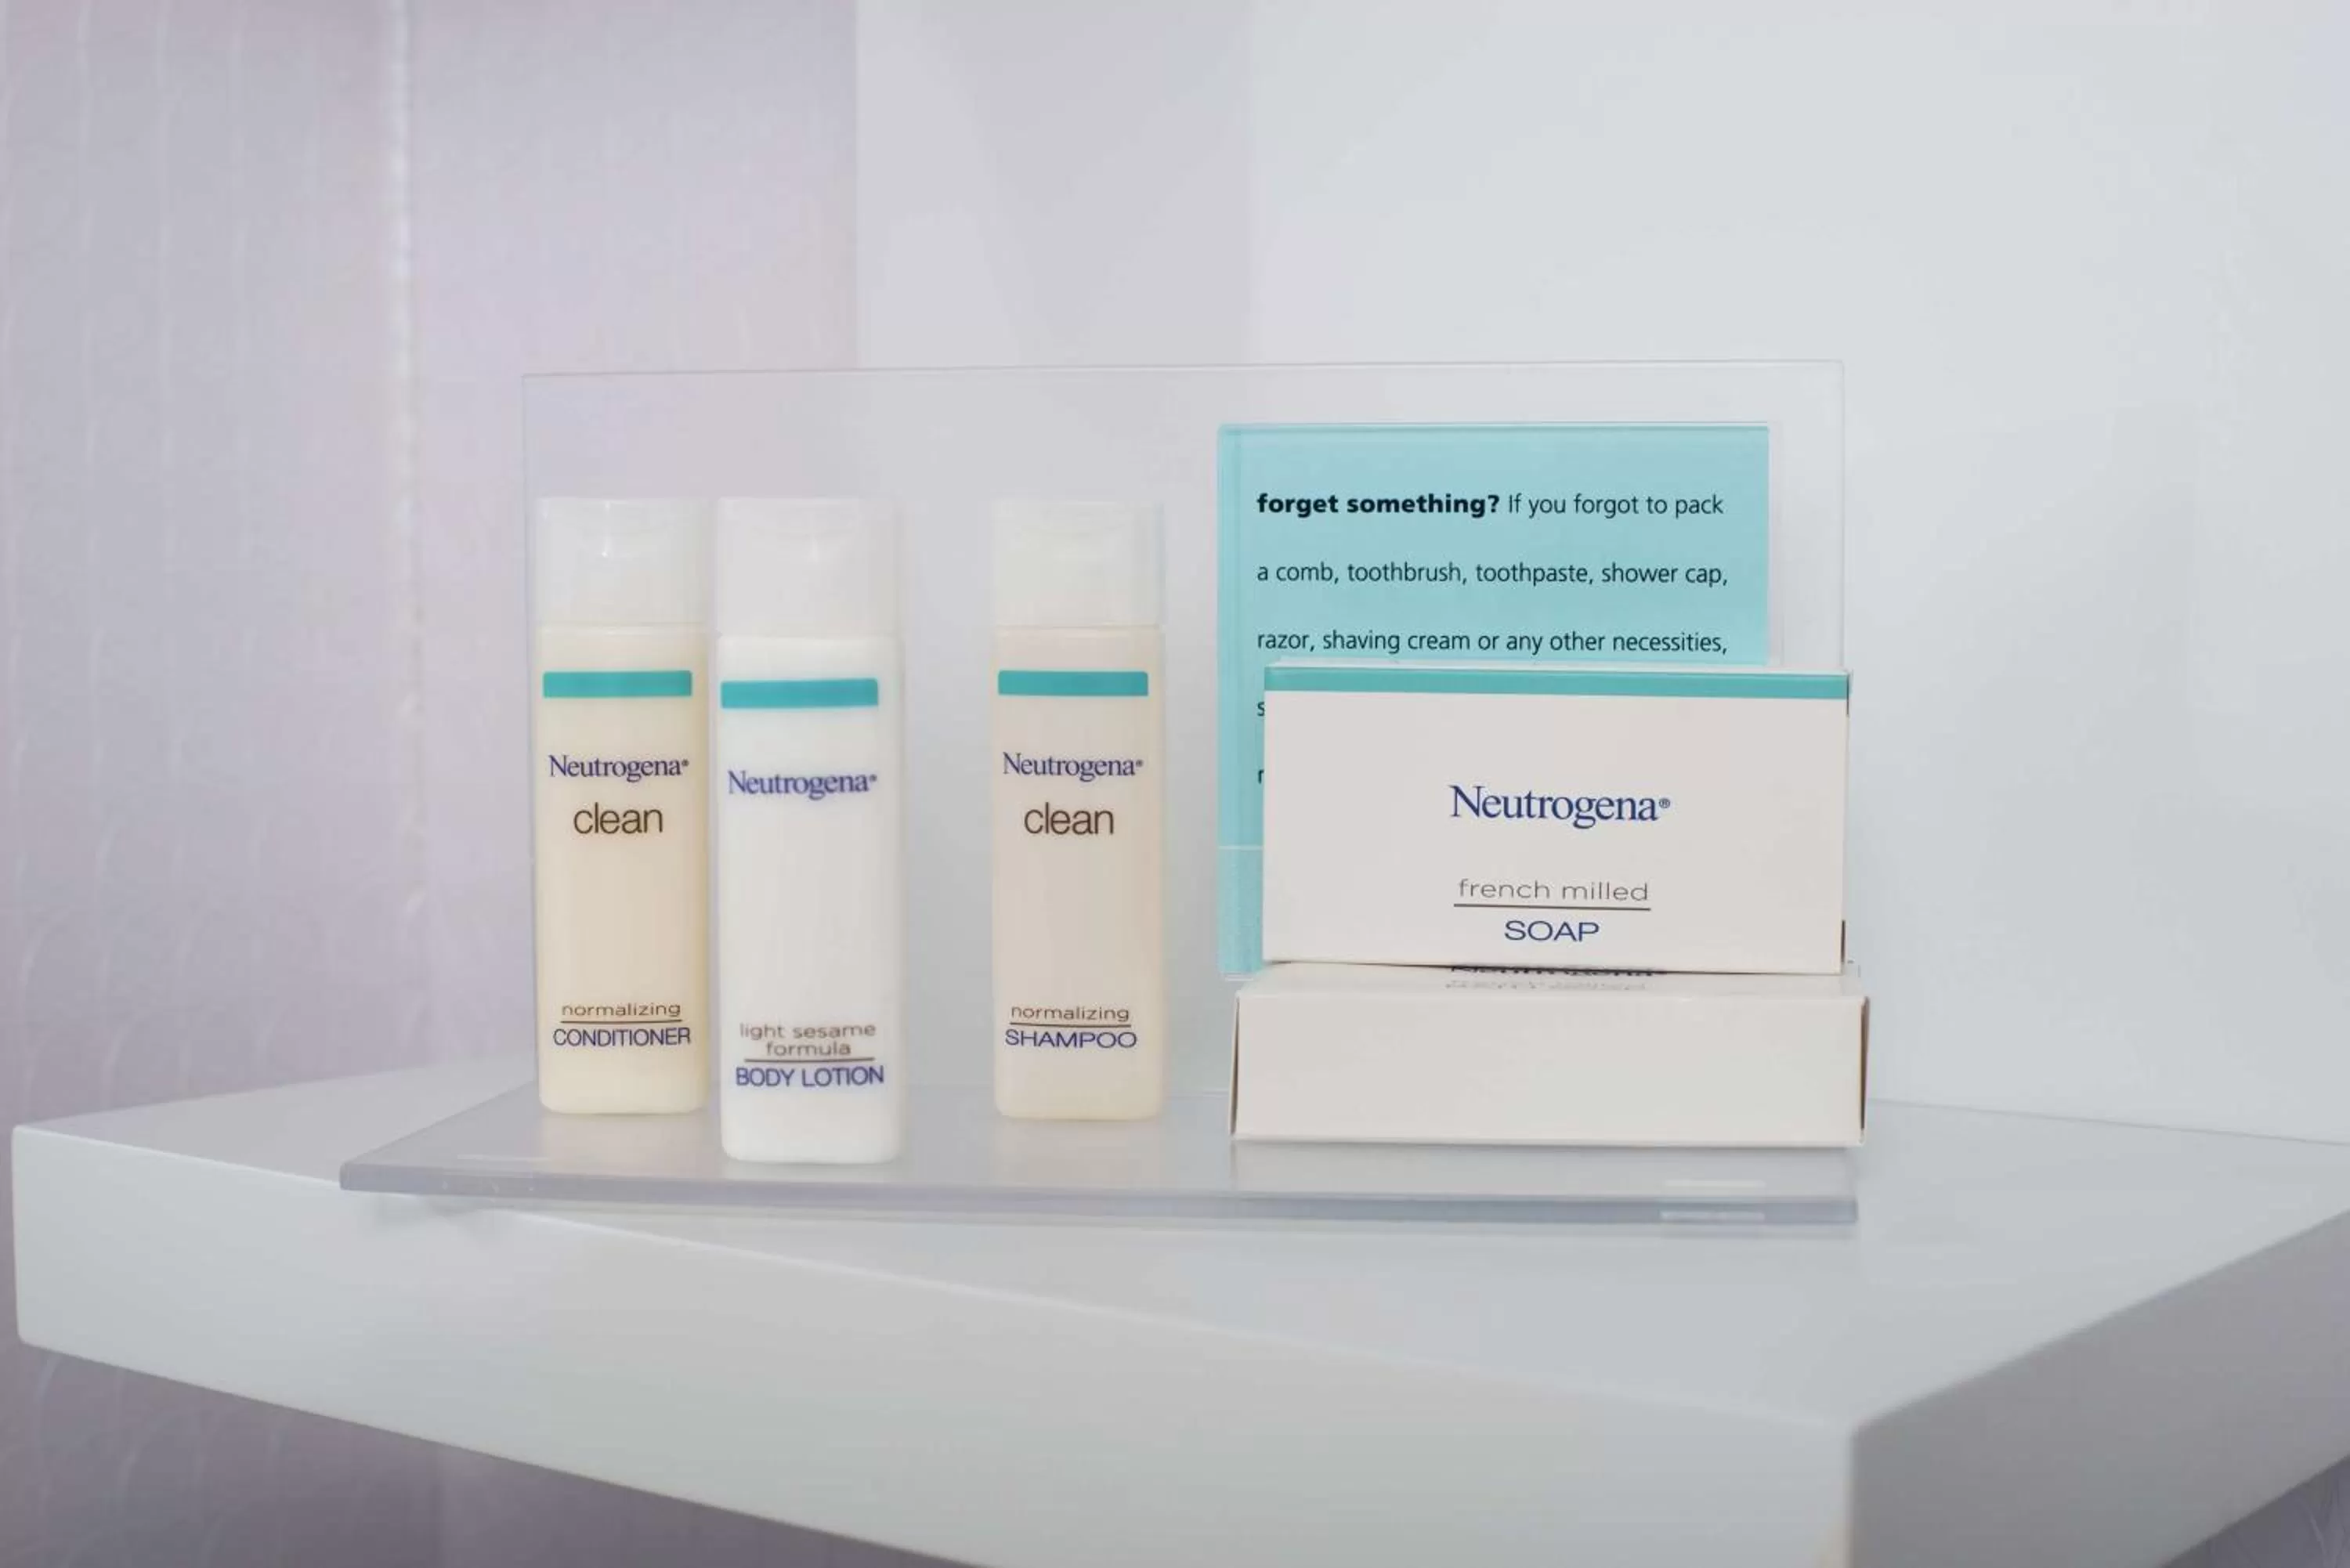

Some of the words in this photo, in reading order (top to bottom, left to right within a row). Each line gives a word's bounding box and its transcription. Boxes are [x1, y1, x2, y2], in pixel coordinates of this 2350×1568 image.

[1256, 493, 1339, 518] forget
[1347, 493, 1500, 519] something?
[1509, 493, 1522, 514] If
[1528, 498, 1567, 519] you
[1573, 493, 1640, 519] forgot
[1646, 496, 1668, 515] to
[1675, 494, 1724, 519] pack
[1256, 565, 1269, 582] a
[1275, 562, 1340, 585] comb,
[1347, 562, 1467, 586] toothbrush,
[1475, 562, 1594, 587] toothpaste,
[1601, 562, 1679, 583] shower
[1685, 567, 1727, 588] cap,
[1257, 634, 1315, 652] razor,
[1322, 630, 1401, 655] shaving
[1407, 634, 1470, 651] cream
[1477, 635, 1500, 651] or
[1506, 635, 1544, 656] any
[1549, 631, 1606, 652] other
[1612, 632, 1727, 656] necessities,
[573, 802, 663, 834] clean
[1025, 802, 1114, 835] clean
[1458, 879, 1550, 899] french
[1562, 881, 1648, 901] milled
[1505, 920, 1600, 941] SOAP
[562, 1002, 681, 1017] normalizing
[1010, 1006, 1130, 1021] normalizing
[553, 1027, 691, 1046] CONDITIONER
[739, 1023, 784, 1039] light
[792, 1024, 877, 1039] sesame
[1005, 1028, 1137, 1048] SHAMPOO
[765, 1041, 851, 1057] formula
[736, 1068, 794, 1087] BODY
[802, 1065, 884, 1087] LOTION
